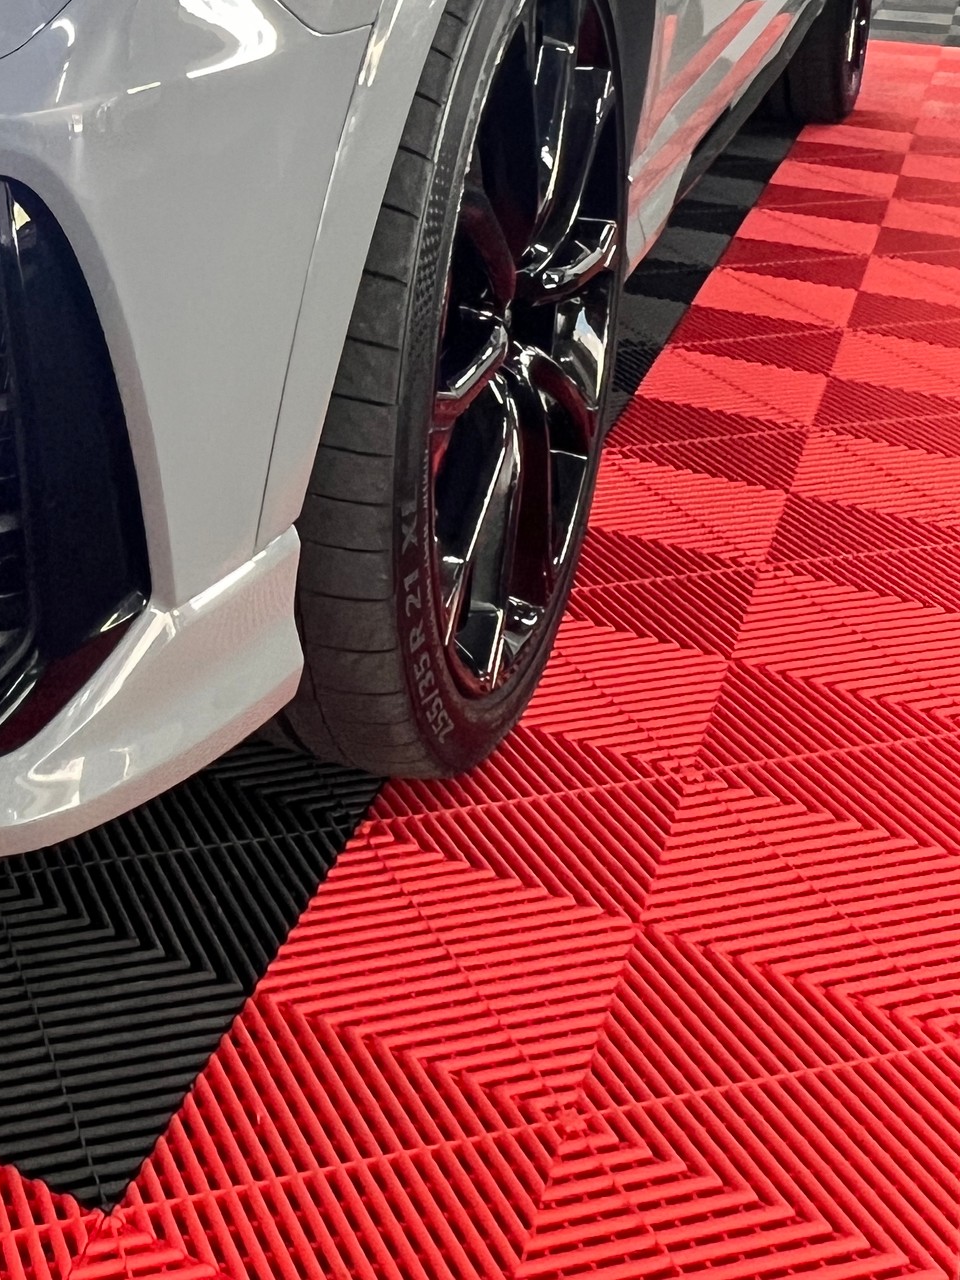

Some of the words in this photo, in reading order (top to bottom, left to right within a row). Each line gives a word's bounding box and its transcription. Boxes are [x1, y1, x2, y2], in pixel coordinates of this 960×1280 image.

[402, 567, 422, 618] 21
[409, 620, 426, 652] R
[413, 652, 455, 744] 255/35
